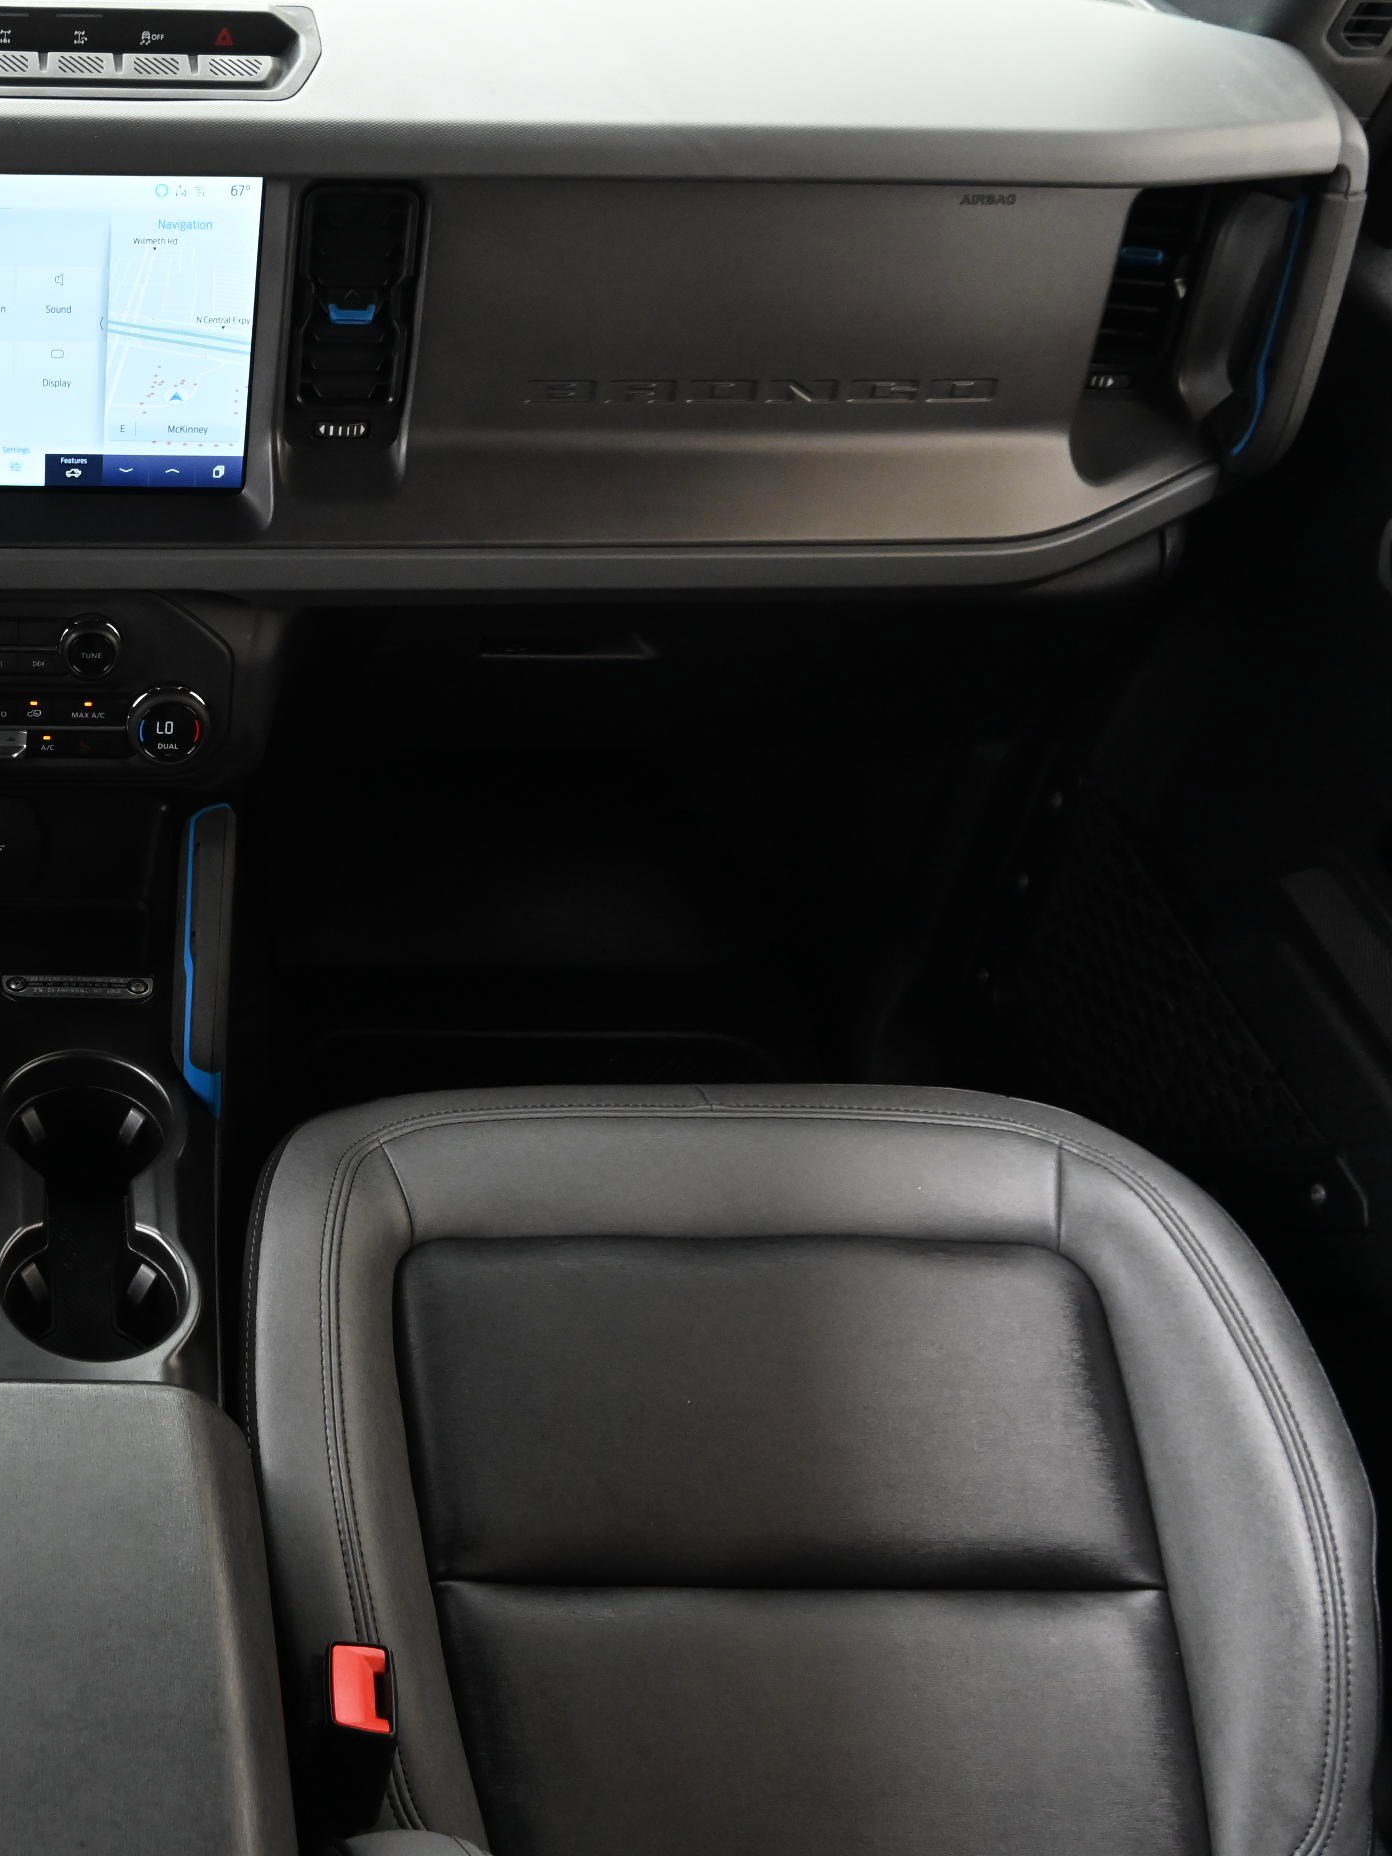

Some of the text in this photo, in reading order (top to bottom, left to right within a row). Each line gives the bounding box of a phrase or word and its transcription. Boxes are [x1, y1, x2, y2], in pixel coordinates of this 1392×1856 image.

[960, 193, 1016, 206] AIRBAG
[158, 219, 213, 232] Navigation
[133, 237, 178, 245] Wilmeth Rd
[45, 305, 72, 314] Sound
[203, 315, 231, 324] Central
[232, 316, 251, 325] Expy
[42, 378, 71, 388] Display
[523, 379, 999, 403] BRONCO
[120, 424, 125, 433] E
[167, 424, 208, 435] McKinney
[2, 447, 30, 455] Settings
[60, 457, 88, 465] Features
[80, 652, 103, 660] TUNE
[71, 711, 106, 719] MAX A/C
[156, 720, 175, 735] LO
[40, 744, 56, 752] A/C
[157, 742, 179, 750] DUAL
